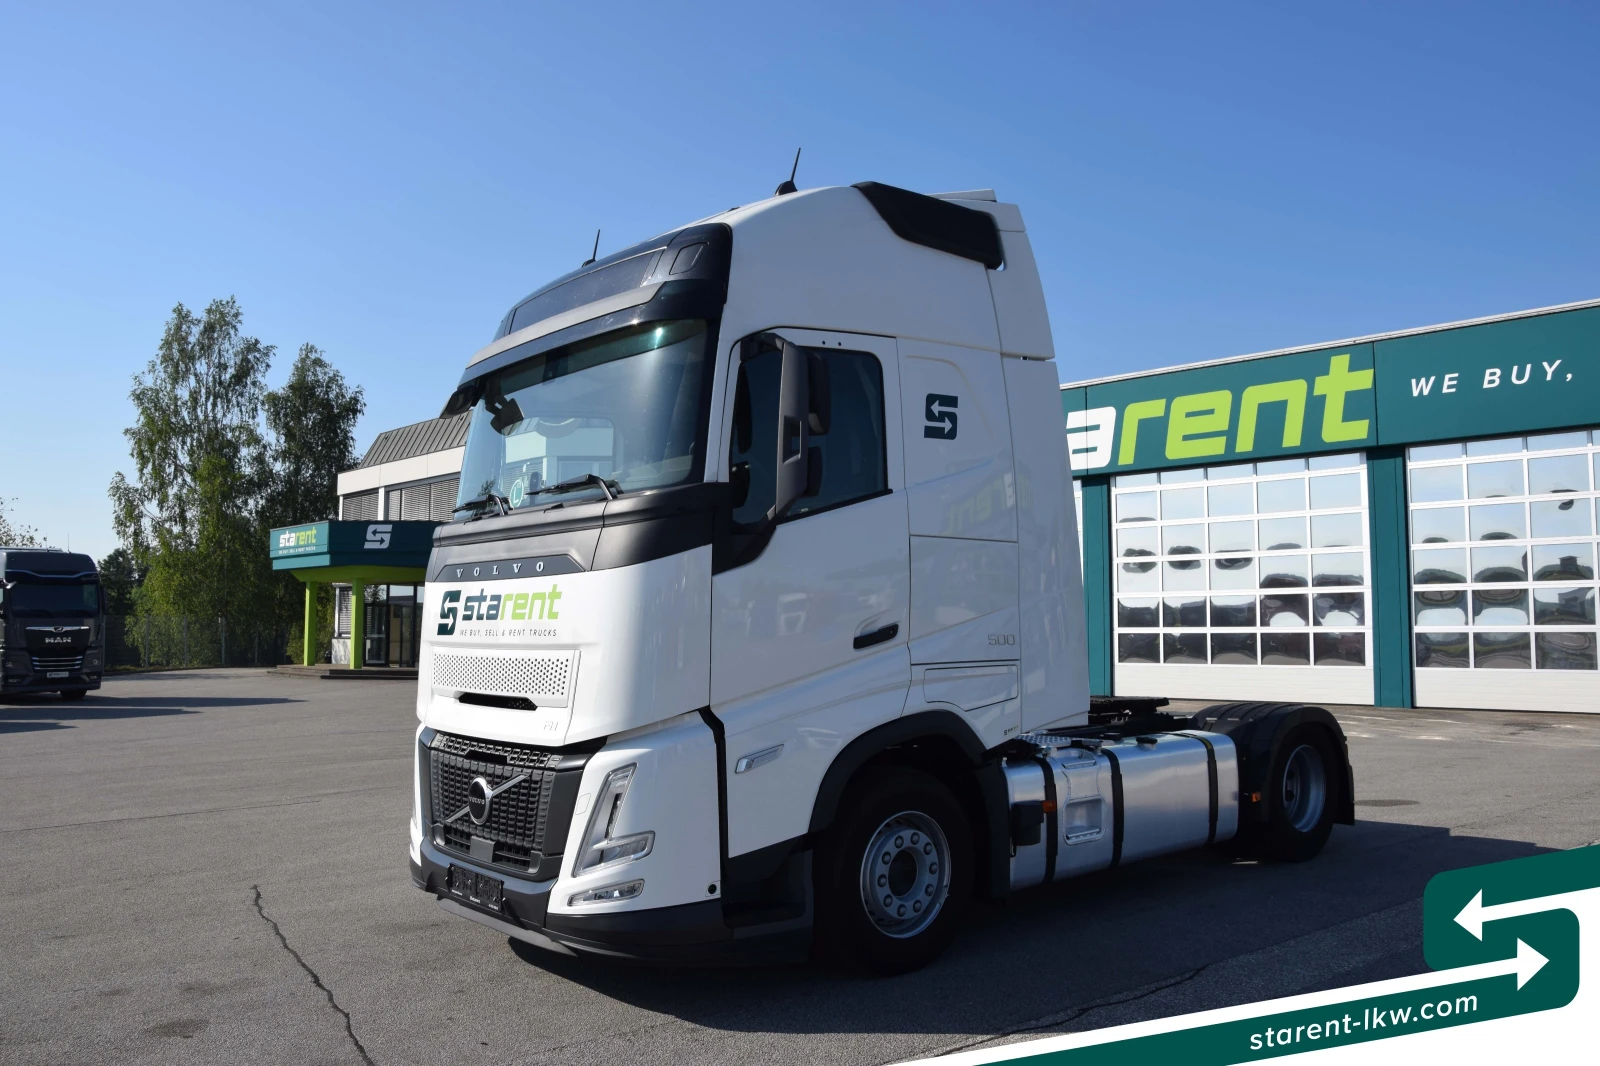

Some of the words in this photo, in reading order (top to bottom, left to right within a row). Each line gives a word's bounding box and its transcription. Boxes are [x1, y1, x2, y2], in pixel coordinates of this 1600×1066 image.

[1410, 372, 1459, 397] WE
[1482, 359, 1573, 389] BUY,
[1065, 353, 1375, 471] arent
[279, 526, 317, 548] starent
[456, 561, 545, 579] VOLVO
[462, 584, 562, 621] starent
[459, 629, 467, 637] WE
[485, 628, 498, 637] SELL
[509, 628, 526, 637] RENT
[529, 628, 557, 637] TRUCKS
[987, 634, 1016, 646] 500
